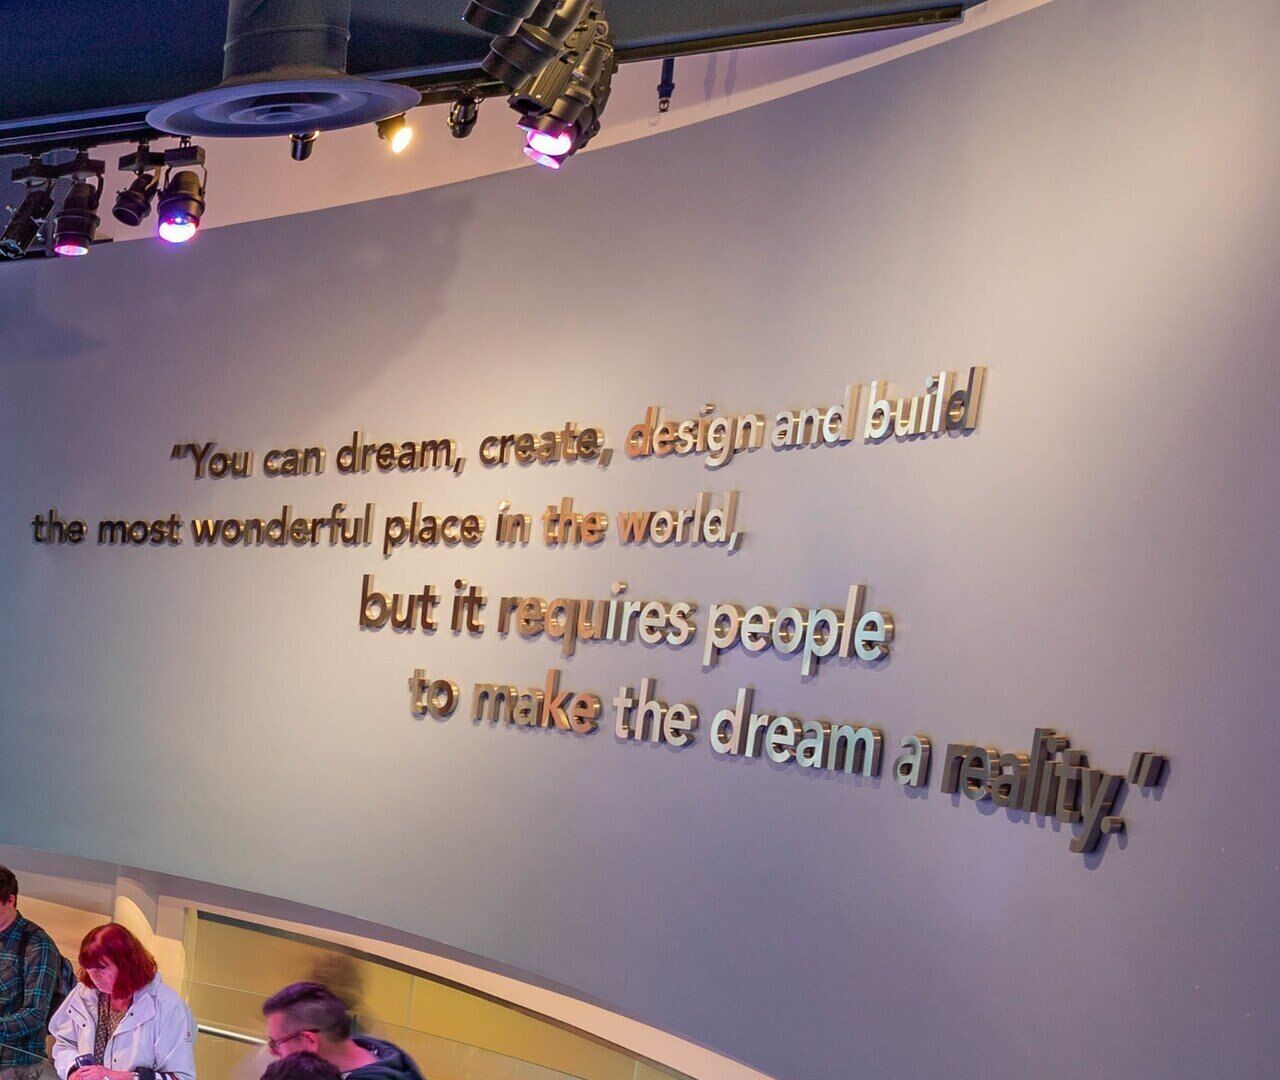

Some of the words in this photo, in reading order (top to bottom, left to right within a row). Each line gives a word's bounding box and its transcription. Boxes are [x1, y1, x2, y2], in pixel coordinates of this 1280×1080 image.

[170, 441, 253, 480] "You
[263, 443, 326, 476] can
[336, 428, 466, 476] dream,
[479, 421, 614, 467] create,
[624, 402, 765, 468] design
[771, 384, 862, 447] and
[864, 366, 988, 440] build
[32, 508, 87, 545] the
[96, 513, 182, 545] most
[191, 503, 375, 546] wonderful
[382, 501, 484, 557] place
[495, 500, 531, 544] in
[543, 496, 608, 544] the
[617, 490, 744, 551] world,
[357, 573, 439, 632] but
[451, 578, 487, 633] it
[497, 580, 698, 656] requires
[702, 584, 894, 676] people
[407, 668, 459, 717] to
[472, 668, 602, 734] make
[612, 677, 699, 747] the
[709, 687, 885, 777] dream
[891, 734, 931, 787] a
